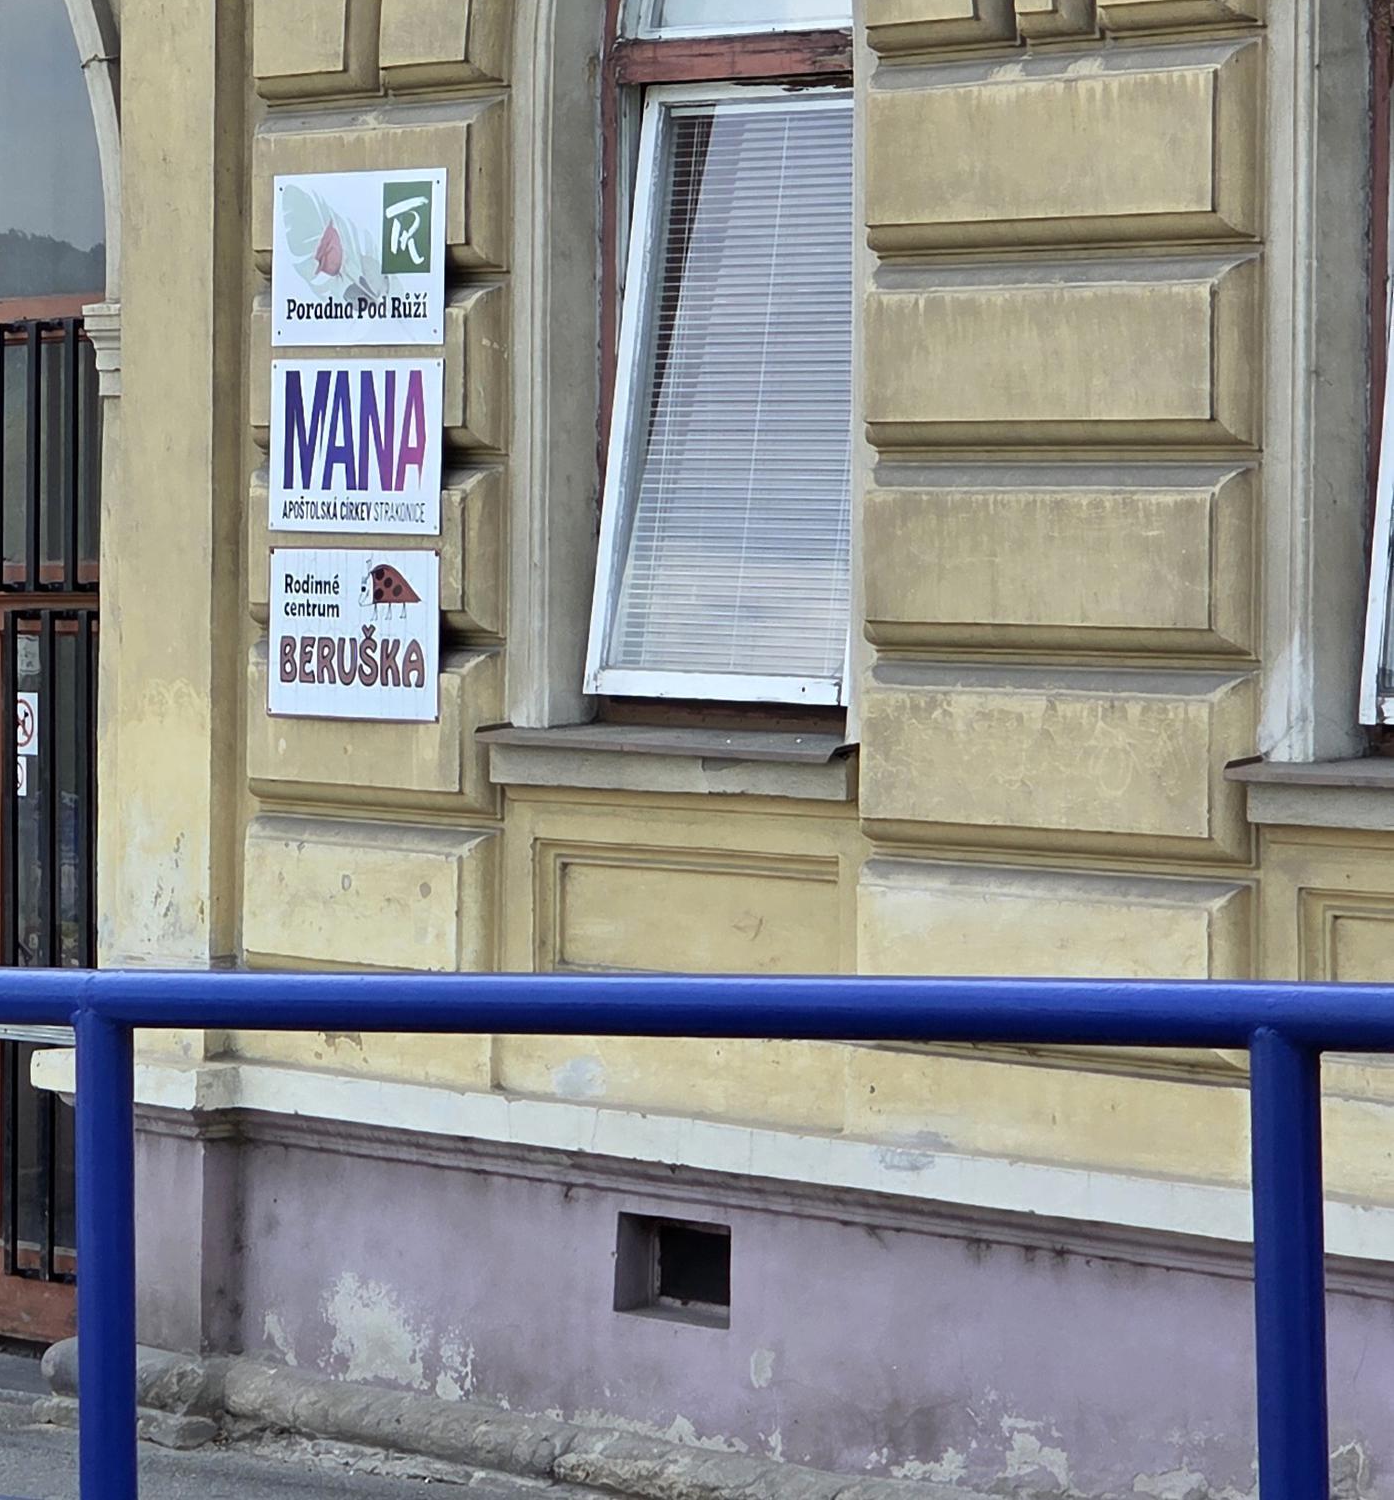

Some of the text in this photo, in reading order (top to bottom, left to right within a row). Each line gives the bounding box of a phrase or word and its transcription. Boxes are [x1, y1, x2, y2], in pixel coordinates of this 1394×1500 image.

[286, 292, 428, 320] Poradna Pod Růží
[283, 370, 427, 491] MANA
[282, 495, 426, 523] APOŠTOLSKÁ CÍRKEV STRAKONICE
[285, 574, 340, 595] Rodinné
[284, 599, 339, 618] centrum
[280, 624, 426, 688] BERUŠKA
